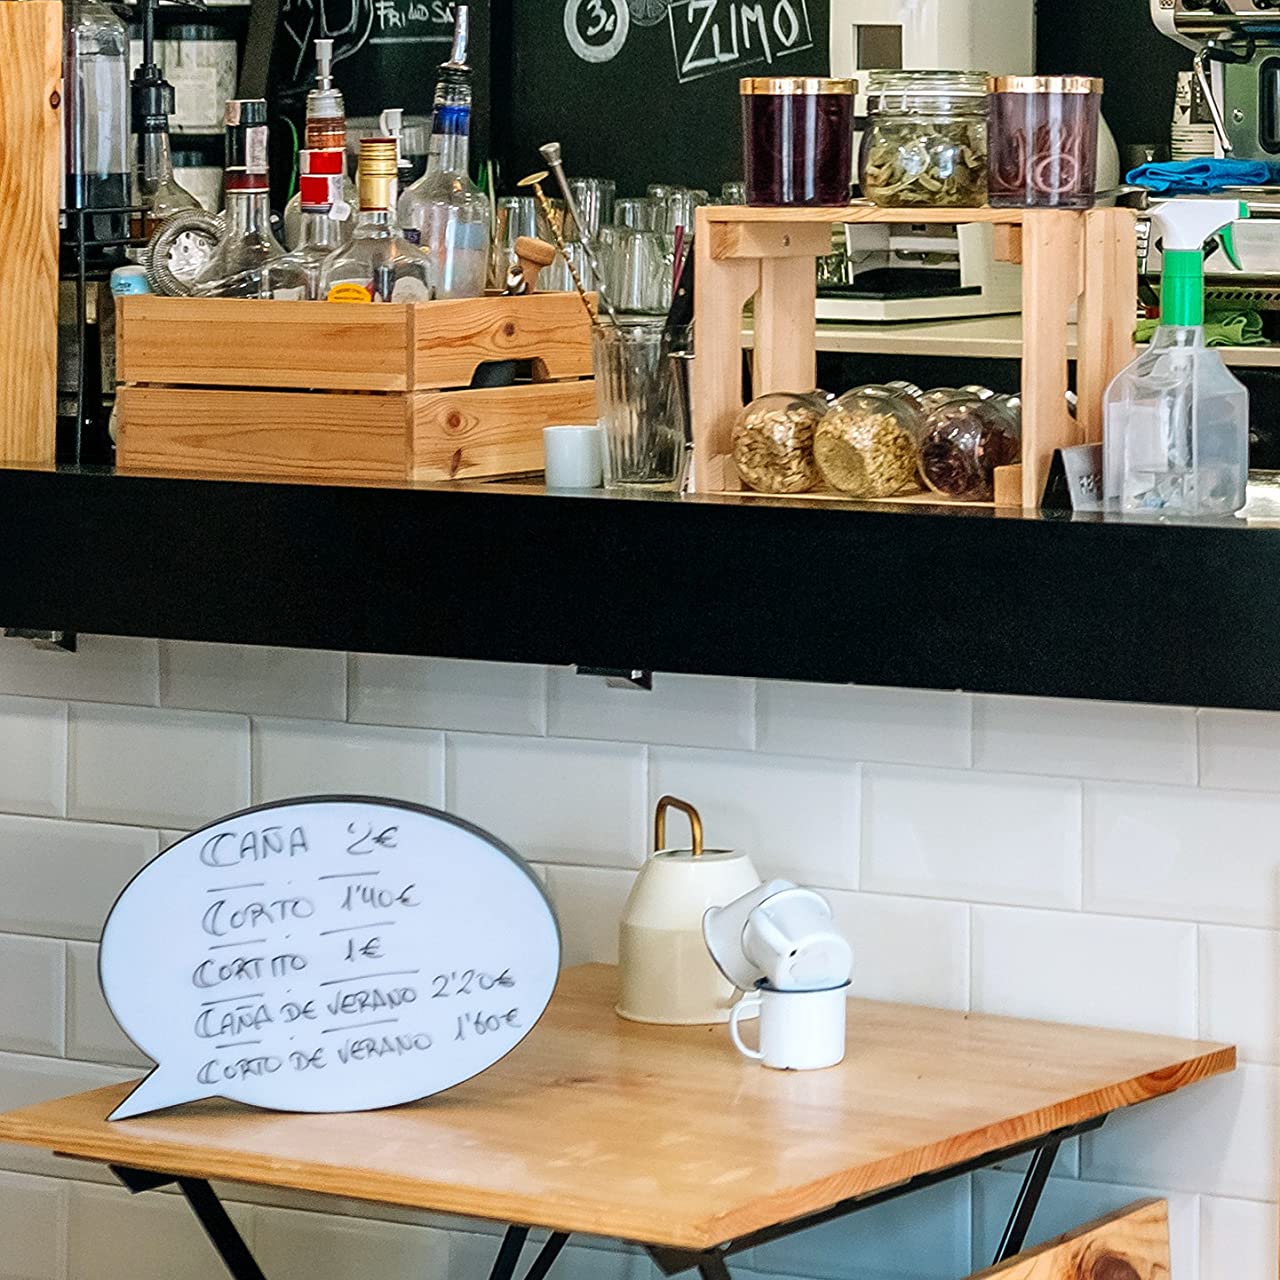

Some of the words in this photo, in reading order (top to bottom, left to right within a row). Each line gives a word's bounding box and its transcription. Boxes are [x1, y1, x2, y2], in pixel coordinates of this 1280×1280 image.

[200, 826, 309, 867] CAÑA
[202, 896, 315, 937] CORTO
[192, 954, 308, 989] CORTITO
[344, 937, 386, 963] 1€
[194, 1004, 274, 1039] CAÑA
[280, 1000, 318, 1024] DE
[327, 987, 418, 1017] VERANO
[196, 1056, 282, 1085] CORTO
[289, 1047, 328, 1071] DE
[337, 1033, 433, 1065] VERANO
